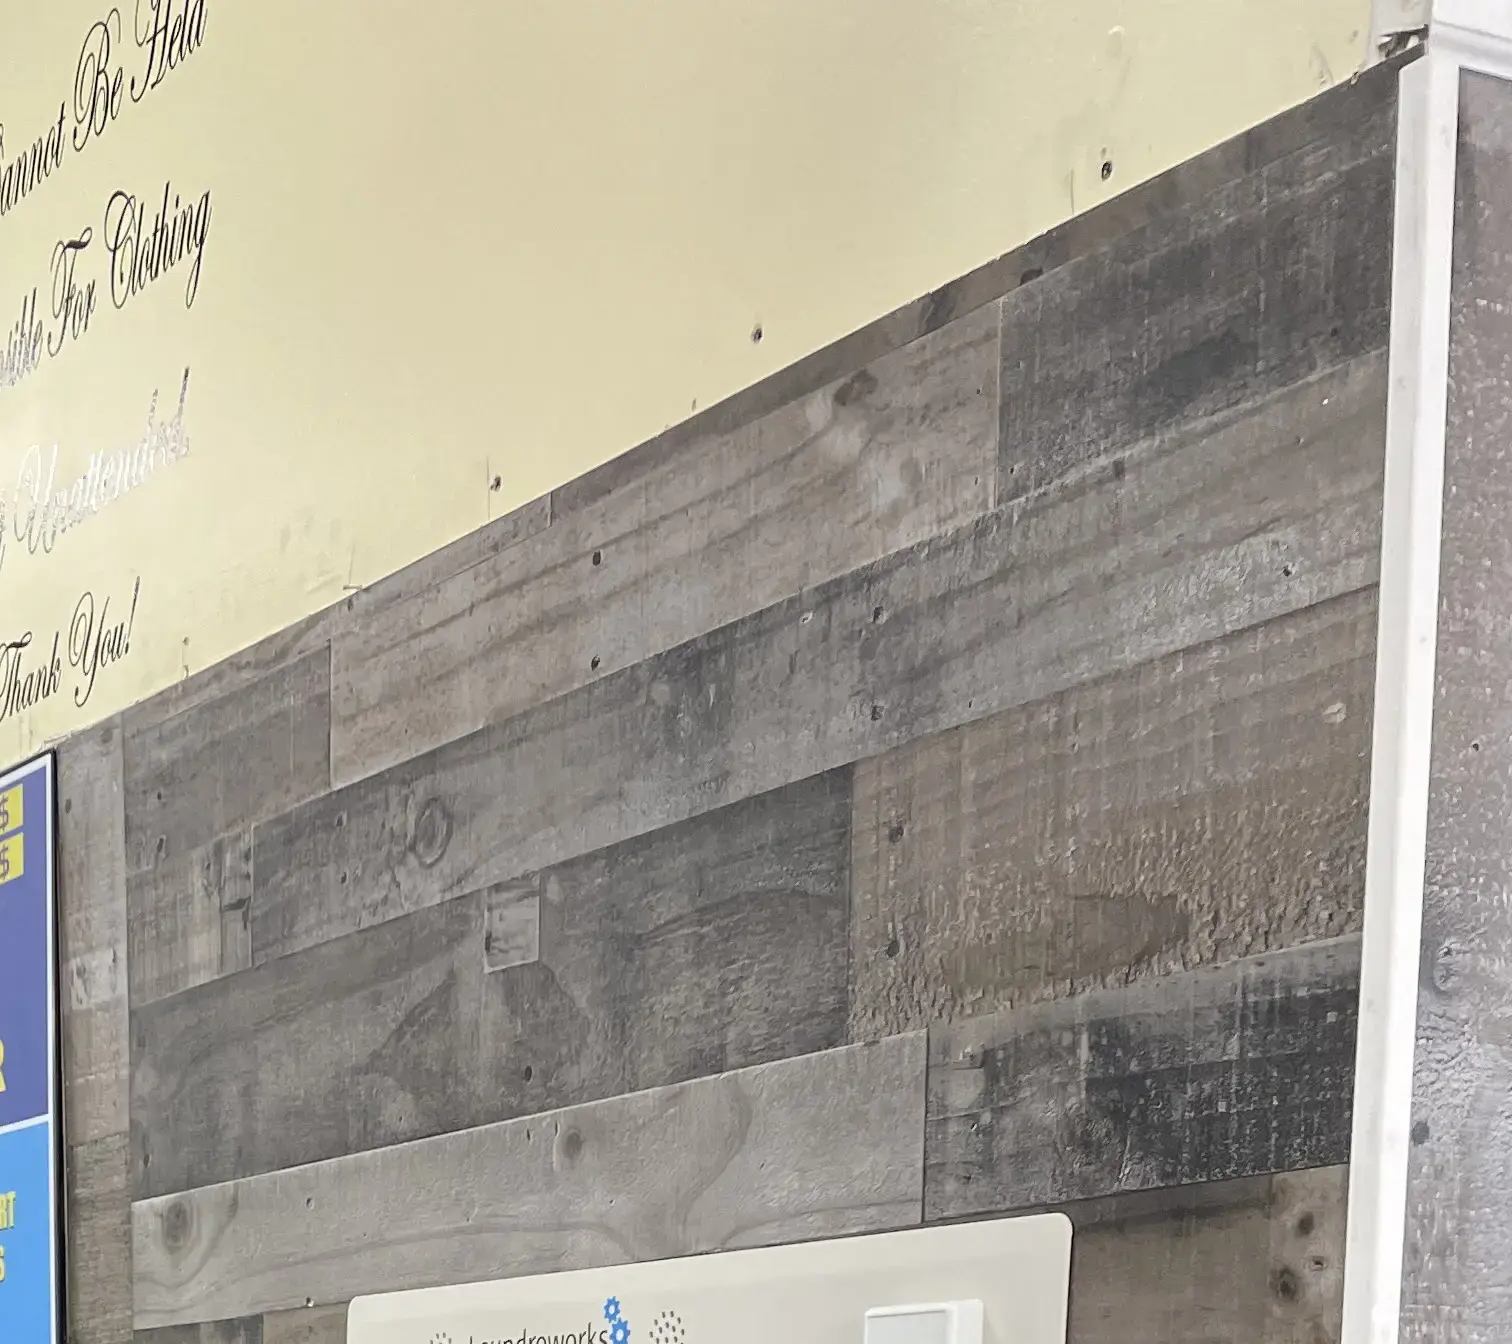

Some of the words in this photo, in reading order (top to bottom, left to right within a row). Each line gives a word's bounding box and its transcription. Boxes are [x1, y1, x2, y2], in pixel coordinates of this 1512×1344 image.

[73, 7, 123, 152] Be
[131, 0, 208, 102] Held
[48, 227, 96, 357] For
[104, 181, 211, 309] Clothing
[68, 575, 140, 707] You!
